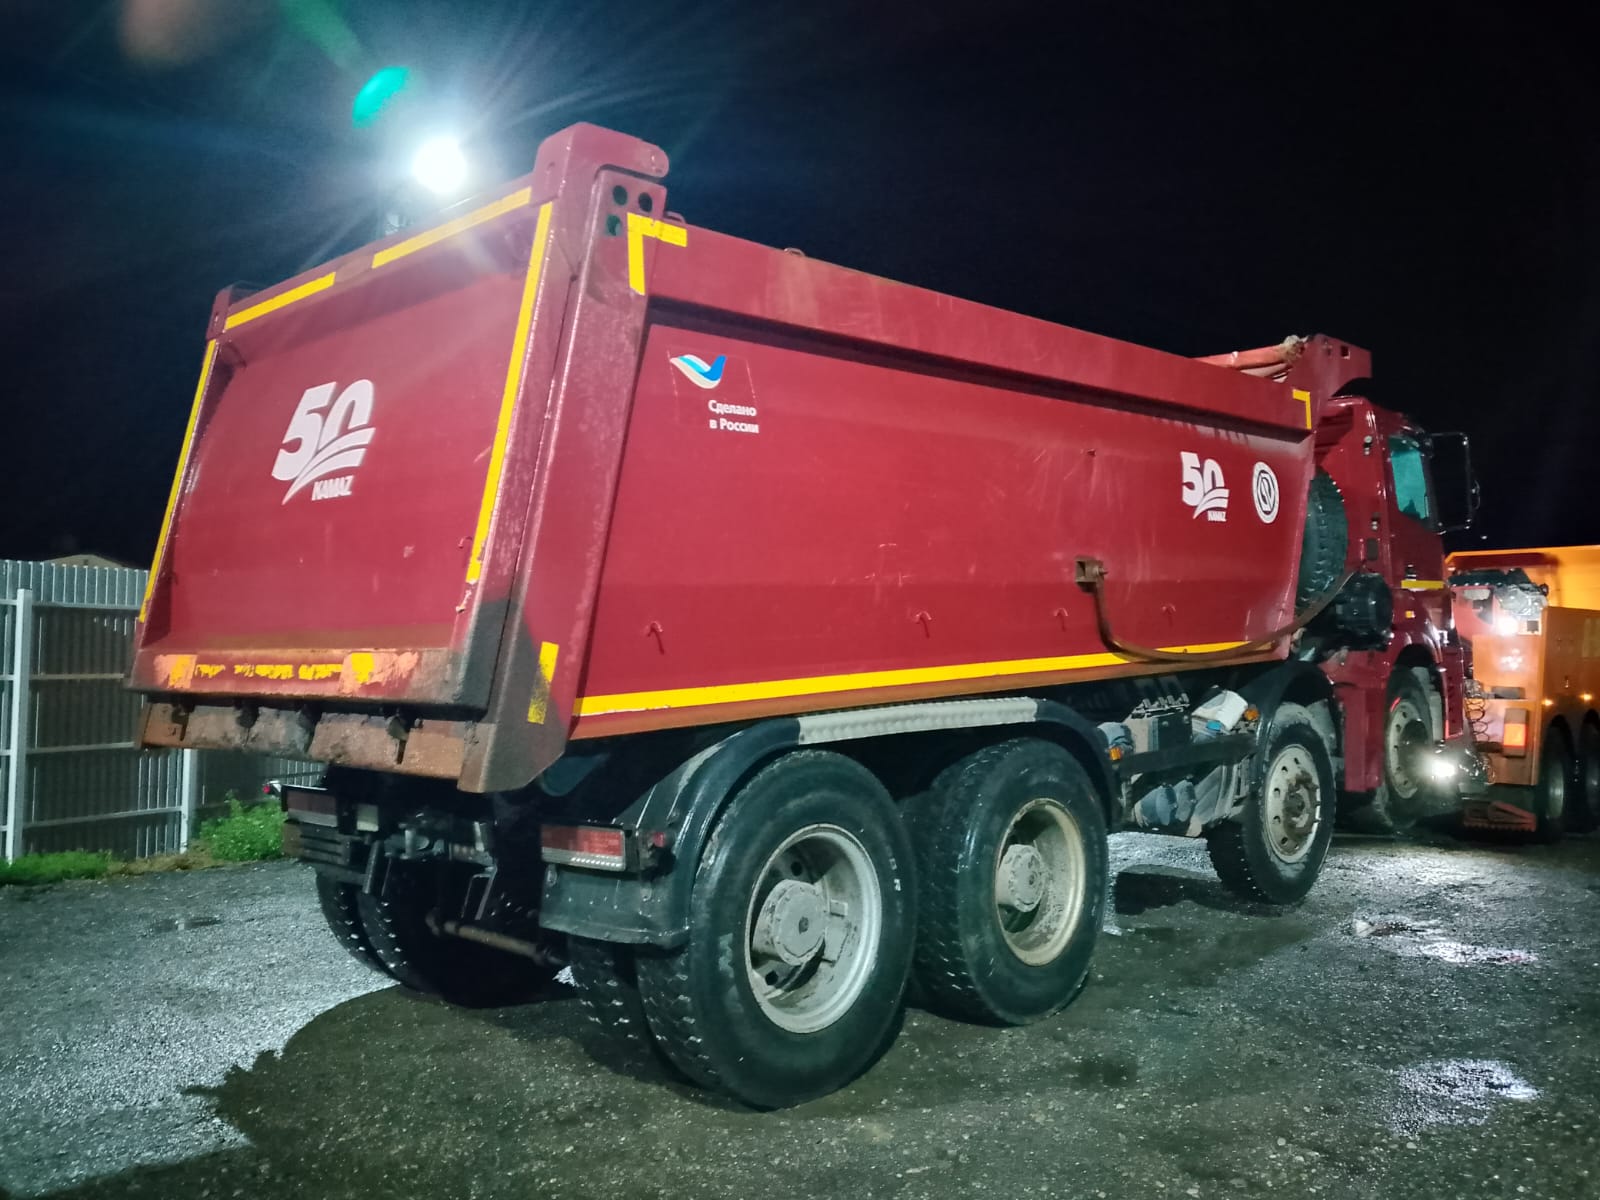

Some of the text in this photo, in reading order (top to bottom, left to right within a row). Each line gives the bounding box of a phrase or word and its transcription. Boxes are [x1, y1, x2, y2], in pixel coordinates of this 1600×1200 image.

[708, 399, 757, 416] Сделано
[709, 418, 759, 433] в России
[271, 379, 376, 484] 50
[1180, 451, 1227, 507] 50
